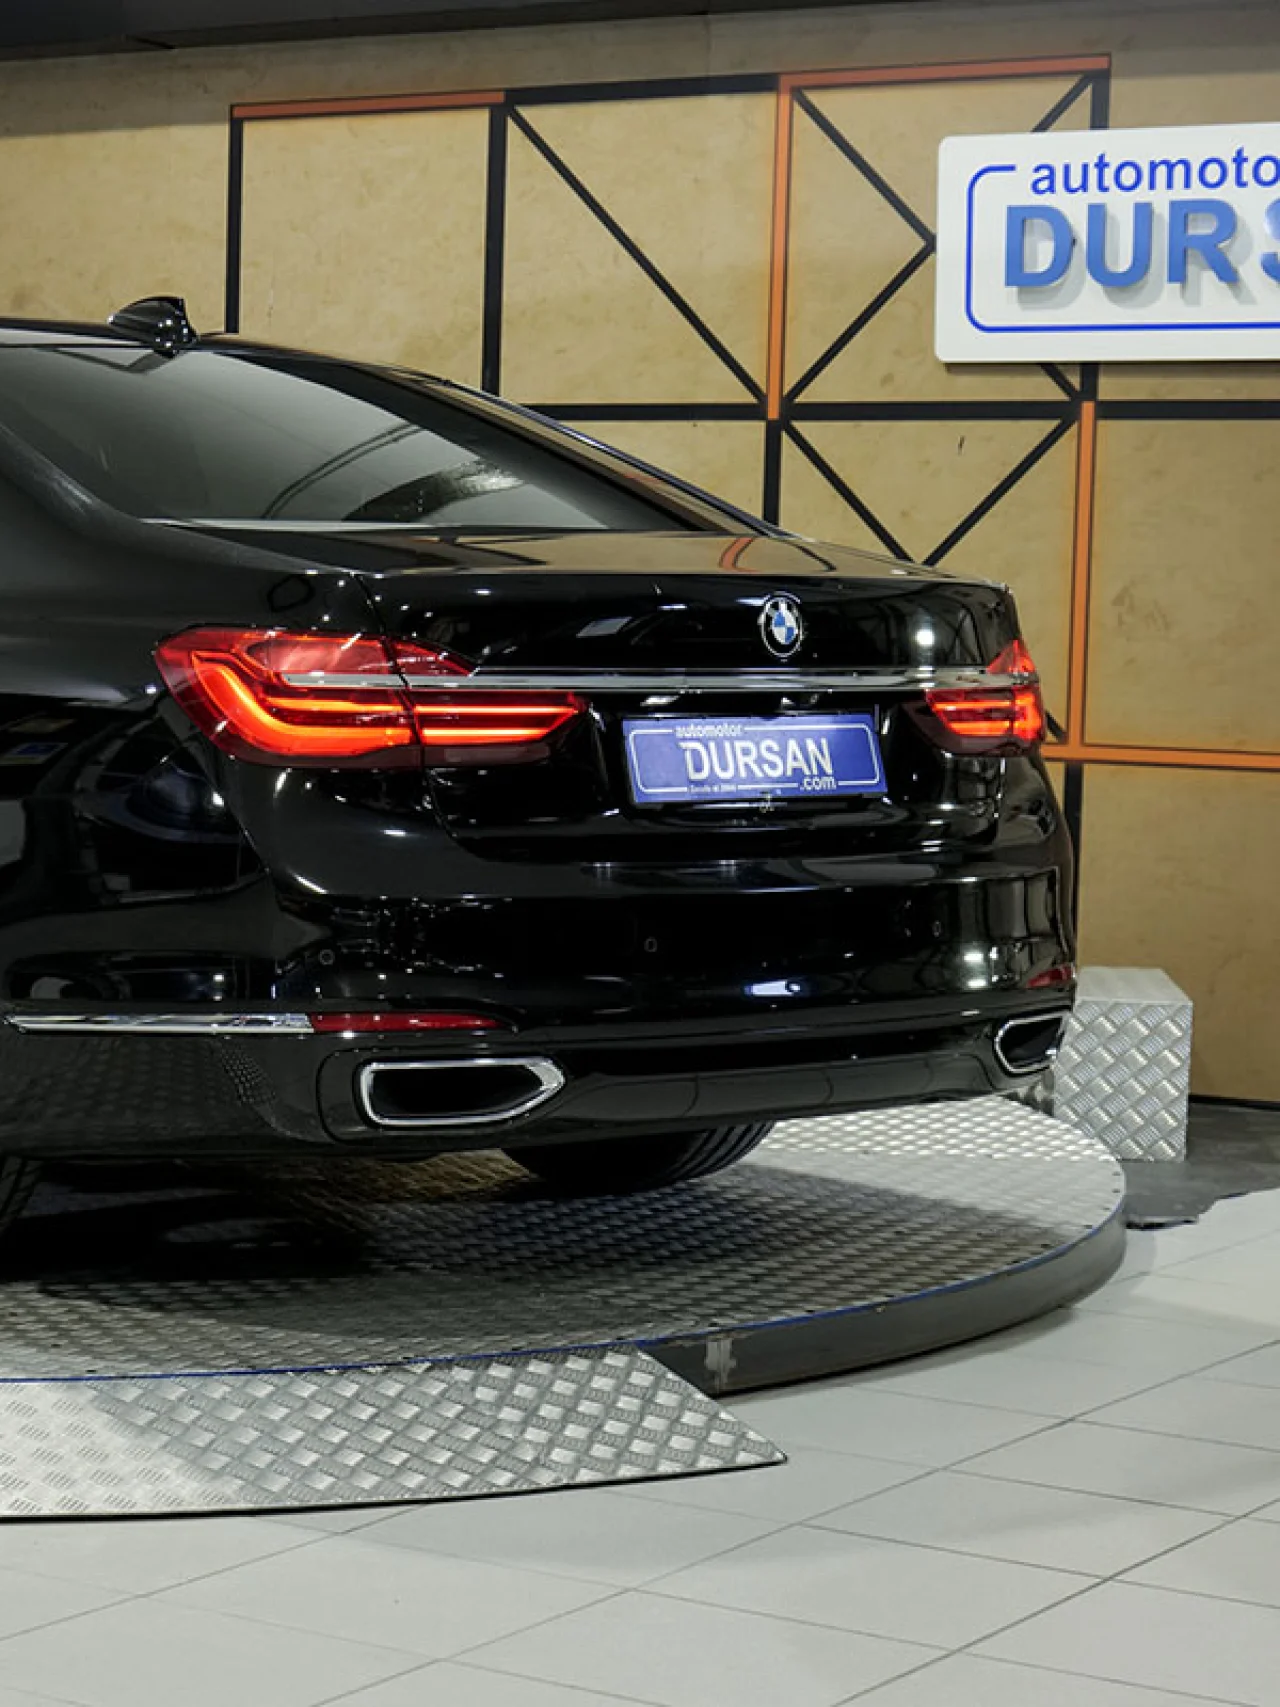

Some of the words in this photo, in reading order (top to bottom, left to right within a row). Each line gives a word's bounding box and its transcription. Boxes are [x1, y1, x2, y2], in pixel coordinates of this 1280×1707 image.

[1030, 148, 1280, 195] automoto
[675, 723, 742, 738] automotor
[678, 738, 833, 780] DURSAN
